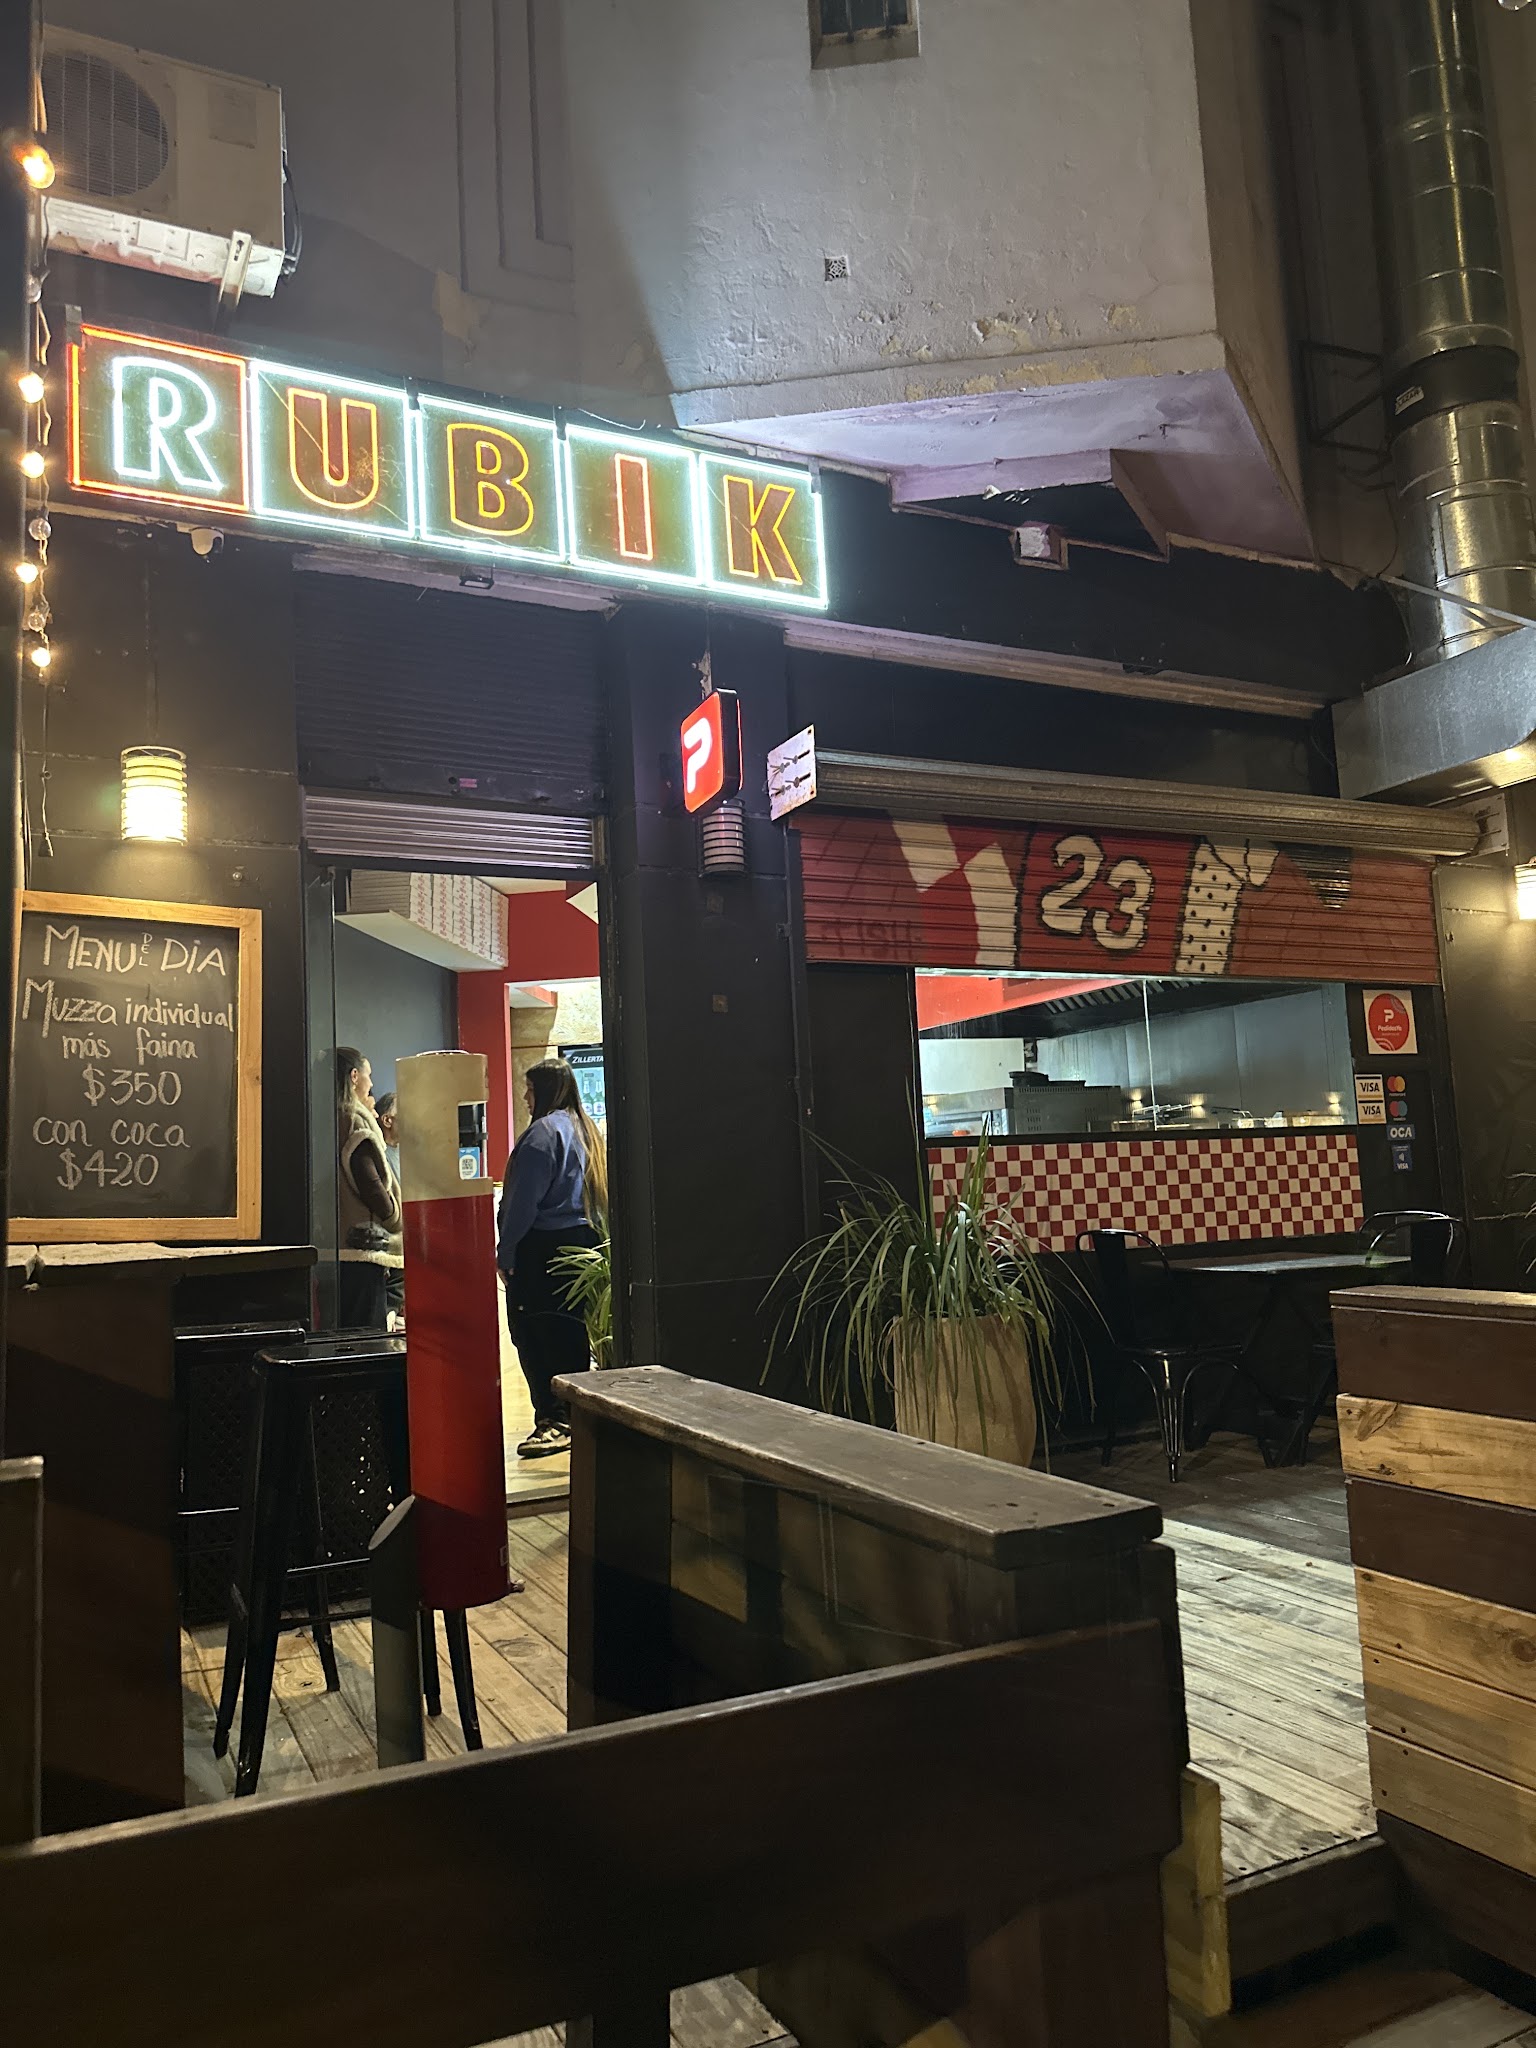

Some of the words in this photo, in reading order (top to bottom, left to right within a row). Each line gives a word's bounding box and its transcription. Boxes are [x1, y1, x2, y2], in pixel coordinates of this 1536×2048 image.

[112, 356, 802, 586] RUBIK
[1041, 834, 1155, 951] 23
[43, 924, 137, 973] MENU
[22, 978, 118, 1038] Muzza
[125, 997, 234, 1032] individual
[62, 1031, 111, 1059] más
[136, 1026, 198, 1066] faina
[82, 1063, 182, 1107] $350
[1359, 1082, 1380, 1093] VISA
[1362, 1105, 1382, 1115] VISA
[32, 1116, 93, 1147] con
[110, 1119, 191, 1148] coca
[1389, 1127, 1413, 1138] OCA
[56, 1148, 159, 1190] $420
[1396, 1162, 1409, 1170] VISA
